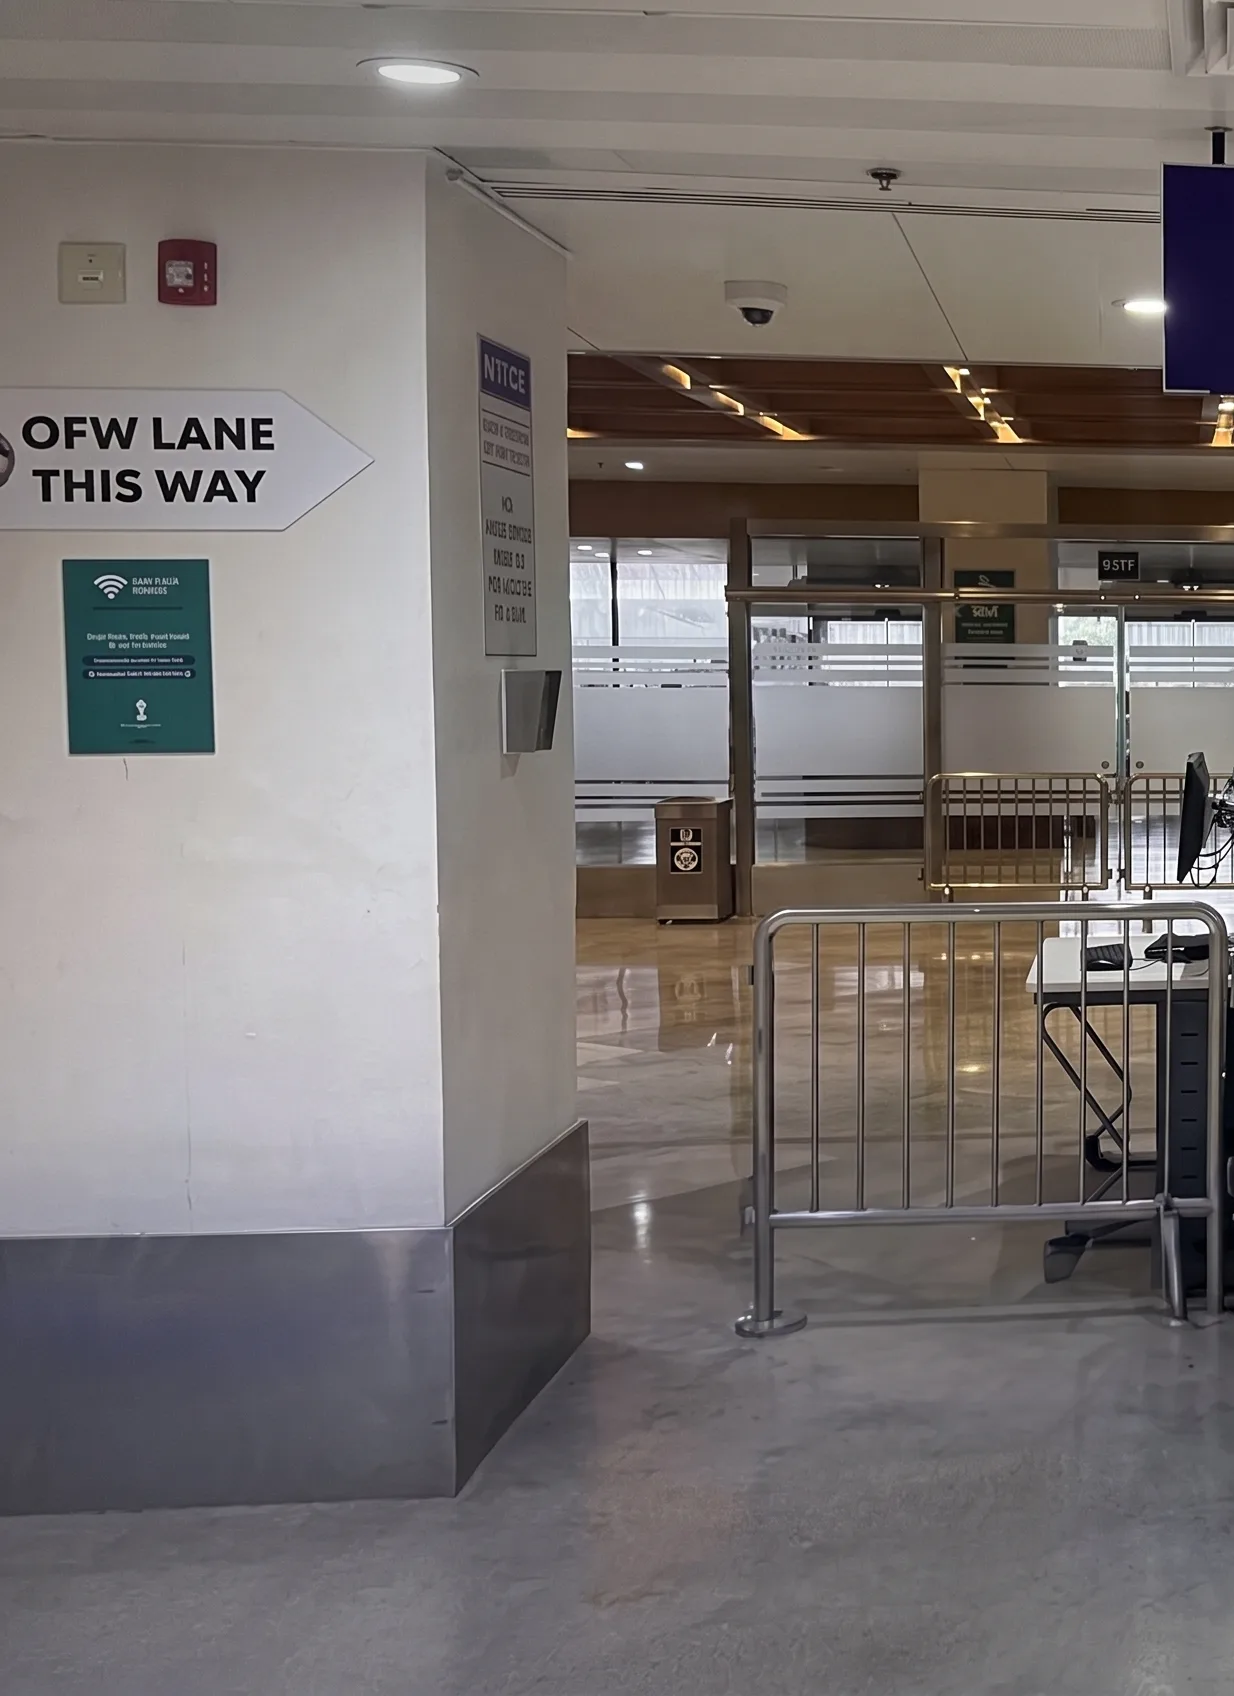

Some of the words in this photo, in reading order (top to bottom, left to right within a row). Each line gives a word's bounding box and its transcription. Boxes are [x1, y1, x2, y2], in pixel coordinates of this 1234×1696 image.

[21, 415, 139, 450] OFW
[152, 416, 275, 451] LANE
[31, 468, 143, 503] THIS
[154, 469, 267, 503] WAY
